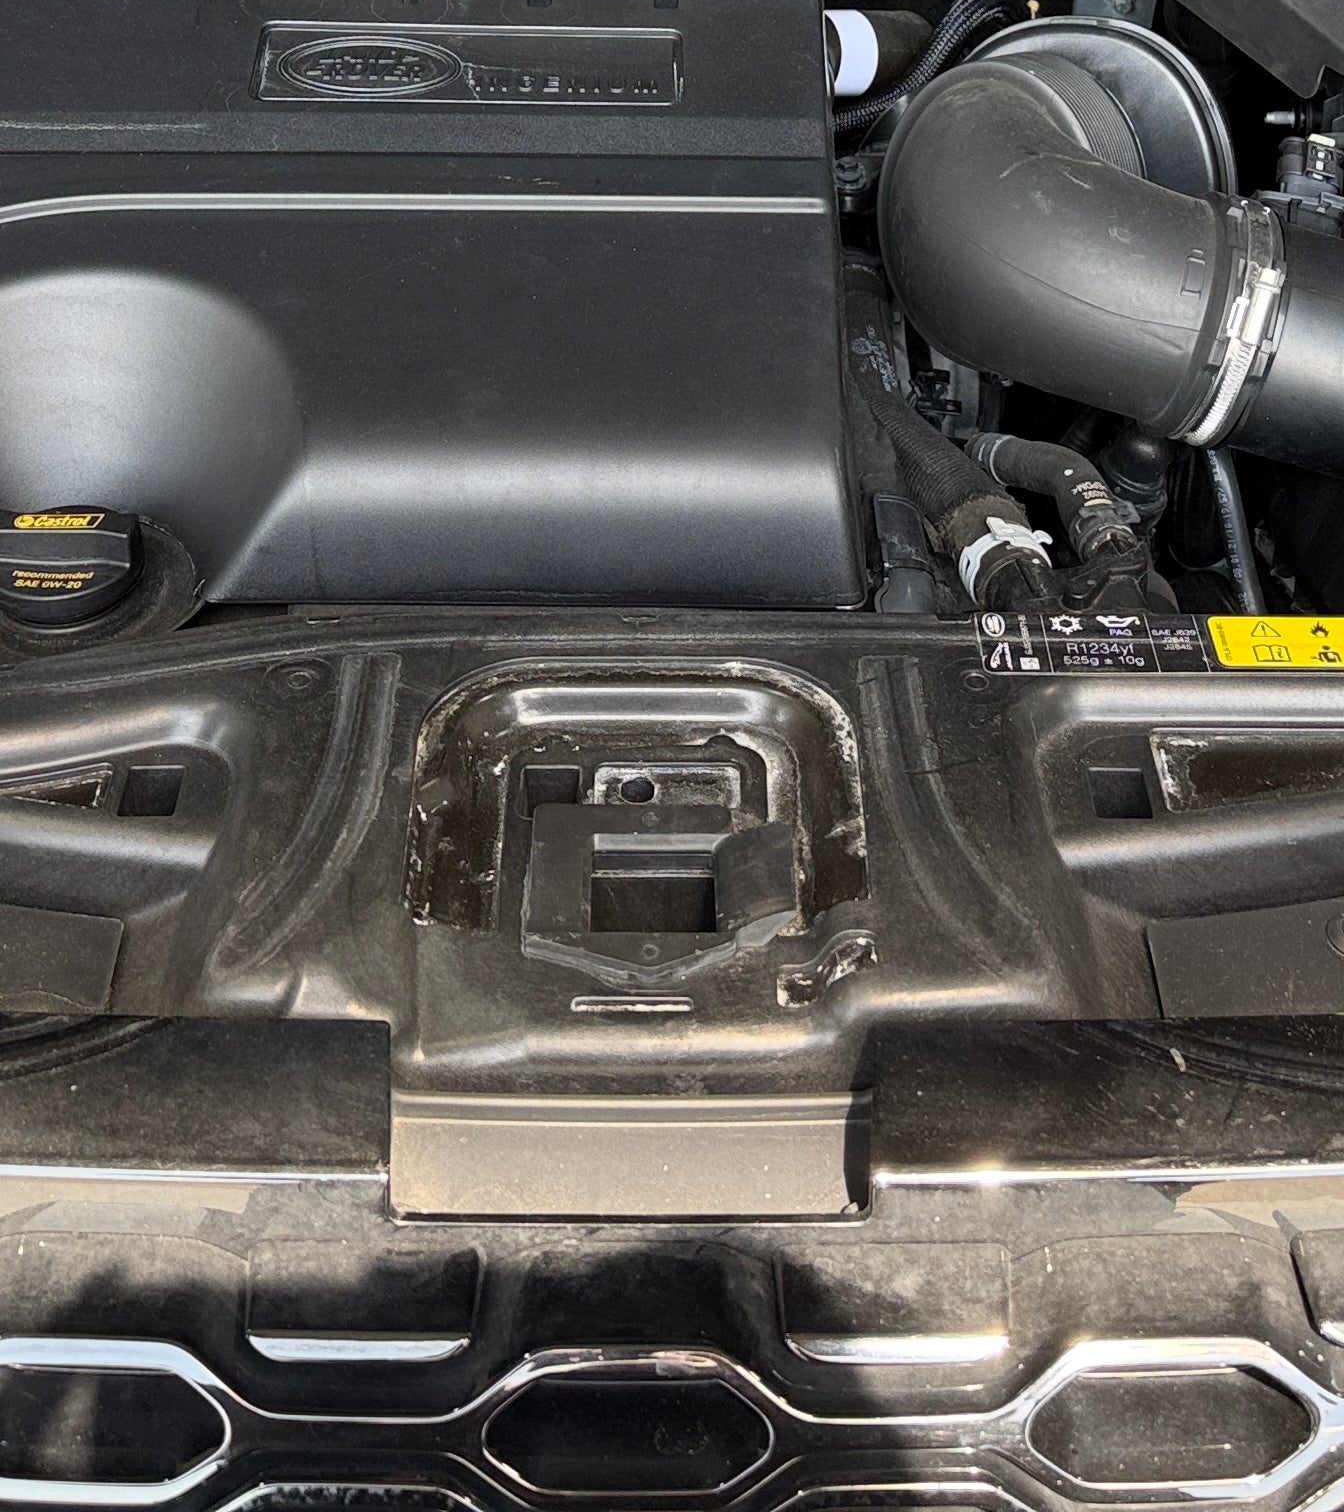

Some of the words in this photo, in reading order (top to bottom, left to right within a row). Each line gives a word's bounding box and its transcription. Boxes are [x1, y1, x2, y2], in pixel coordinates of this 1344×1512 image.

[33, 515, 92, 527] Castrol
[12, 570, 95, 580] recommended
[13, 579, 41, 588] SAE
[41, 580, 83, 589] 0W-20
[1066, 642, 1136, 656] R1234yf
[1118, 655, 1145, 667] 10g
